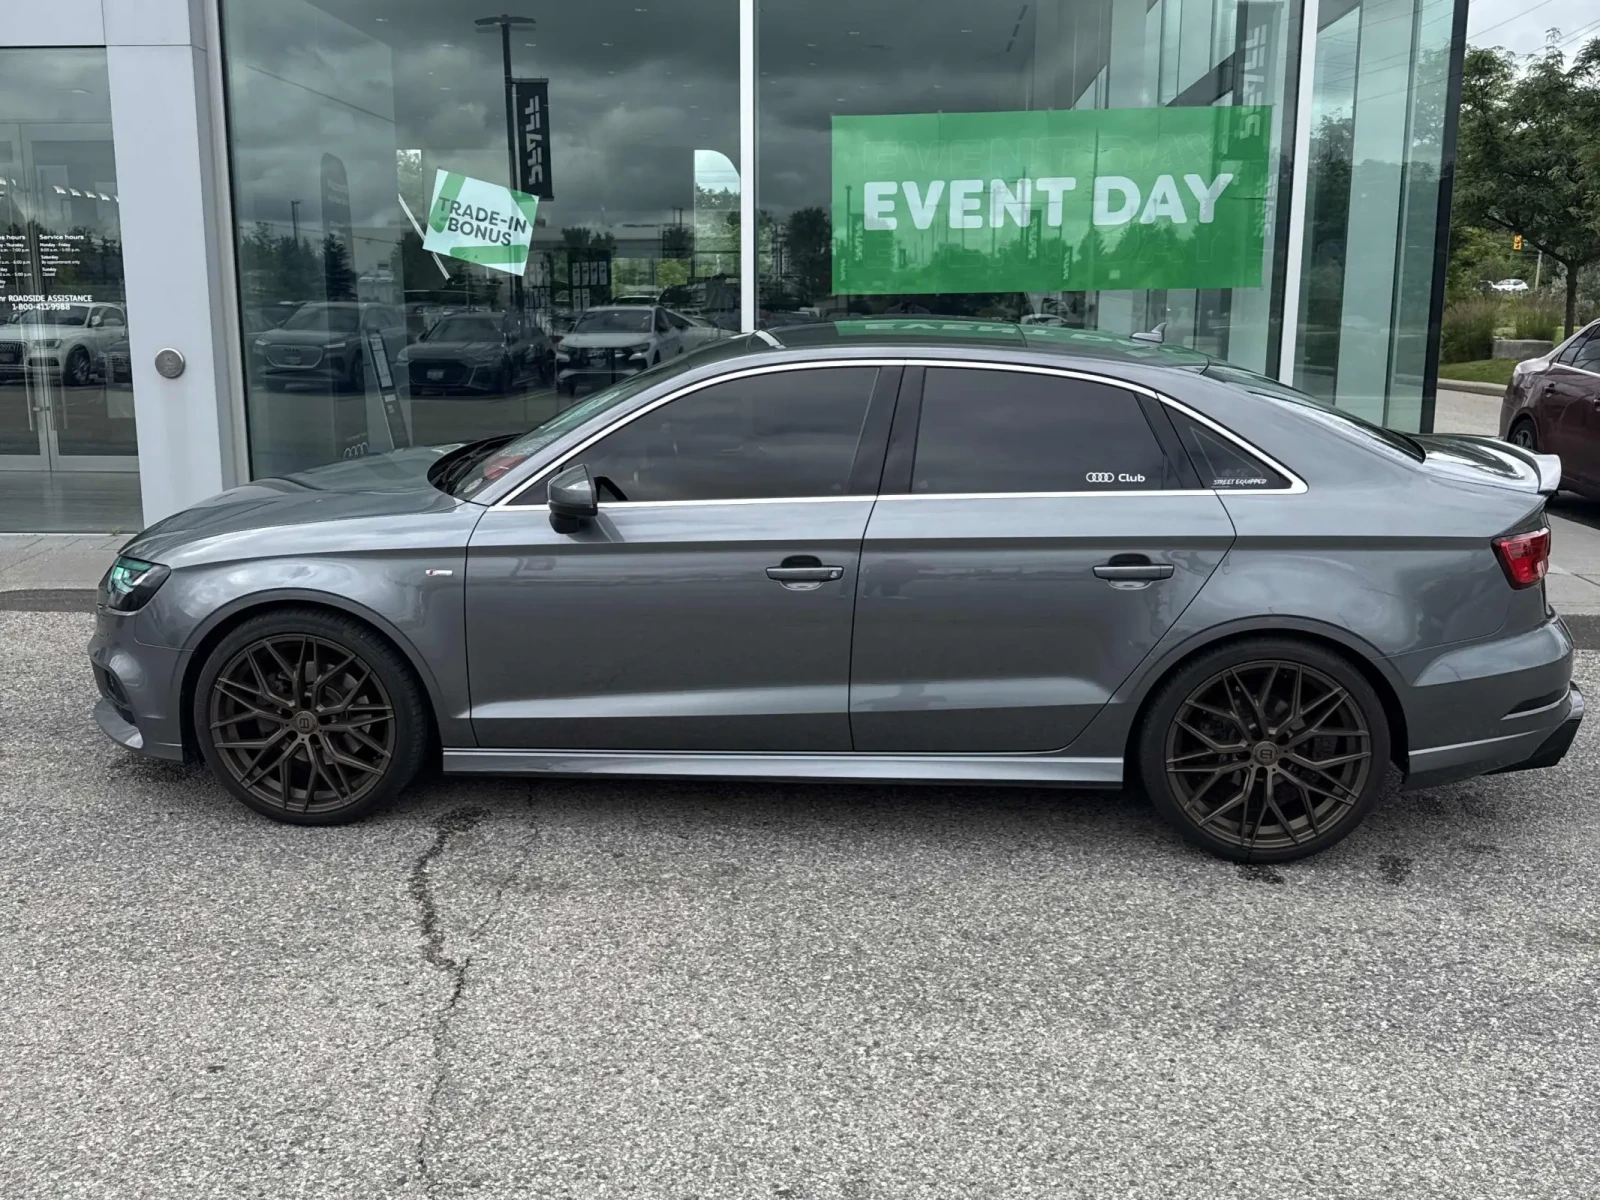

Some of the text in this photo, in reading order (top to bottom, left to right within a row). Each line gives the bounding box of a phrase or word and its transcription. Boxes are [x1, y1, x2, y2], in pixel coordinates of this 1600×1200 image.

[439, 197, 527, 234] TRADE-IN
[864, 173, 1234, 231] EVENT DAY
[447, 217, 512, 247] BONUS
[12, 303, 71, 311] 1-800-411-9988
[1118, 473, 1146, 483] Club
